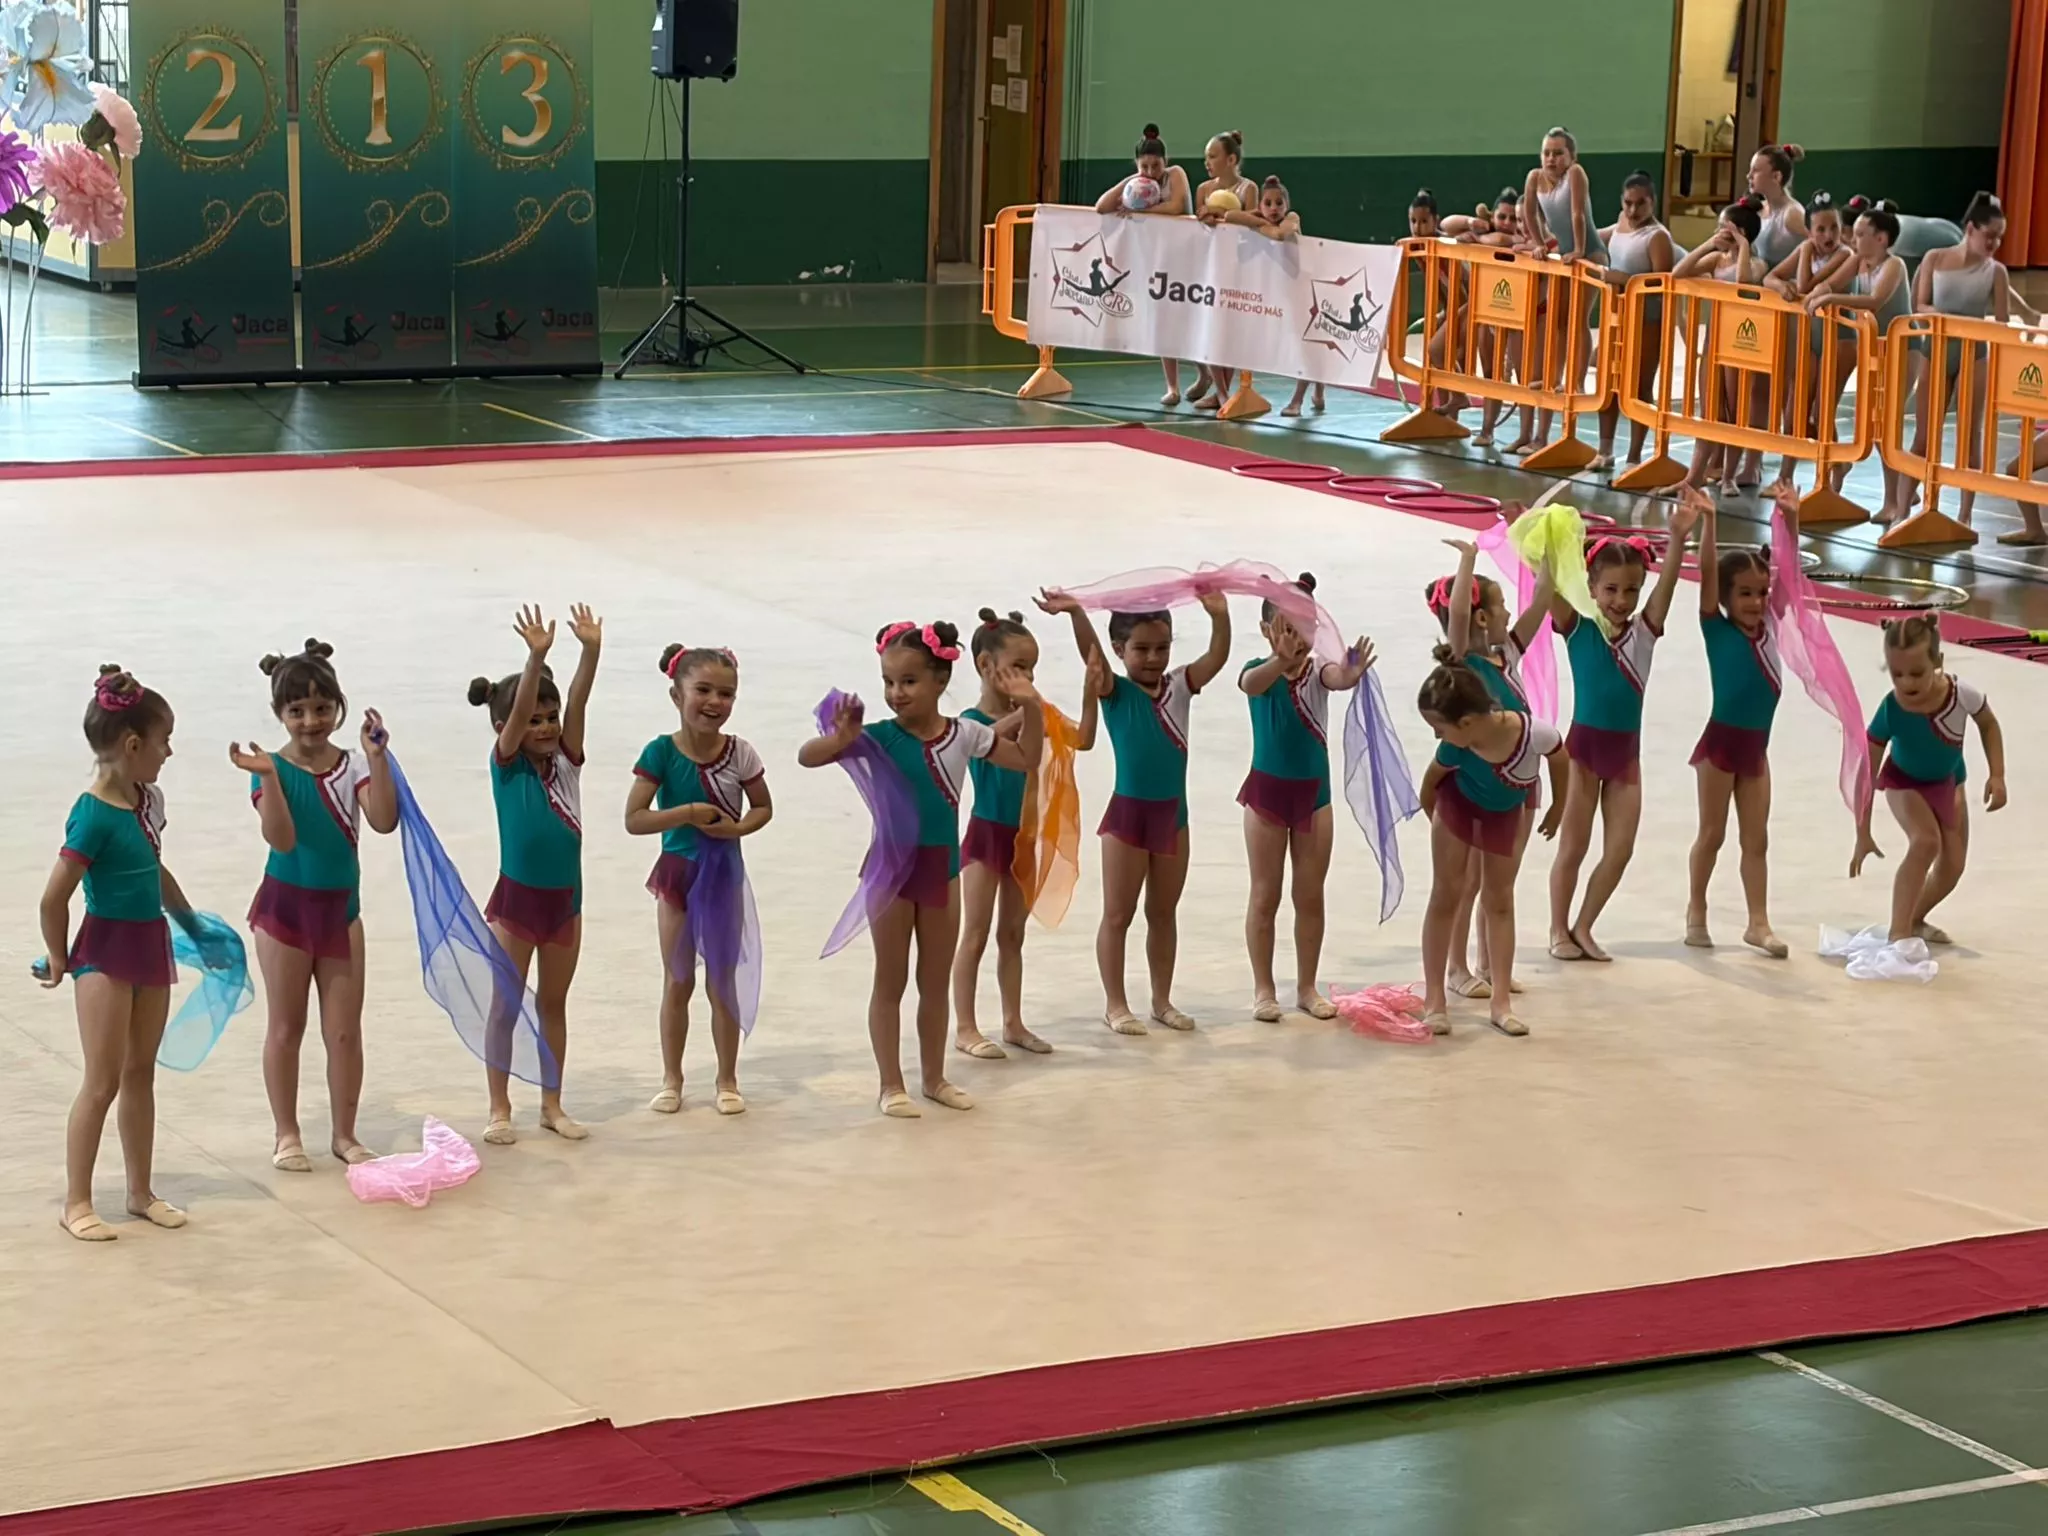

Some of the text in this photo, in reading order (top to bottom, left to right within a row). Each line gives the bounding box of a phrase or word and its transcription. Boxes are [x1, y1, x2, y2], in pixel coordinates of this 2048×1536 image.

[184, 49, 242, 141] 2
[356, 49, 393, 145] 1
[501, 50, 552, 146] 3
[1148, 271, 1216, 307] Jaca
[1219, 287, 1263, 302] PIRINEOS
[1219, 301, 1283, 318] Y MUCHO MÁS
